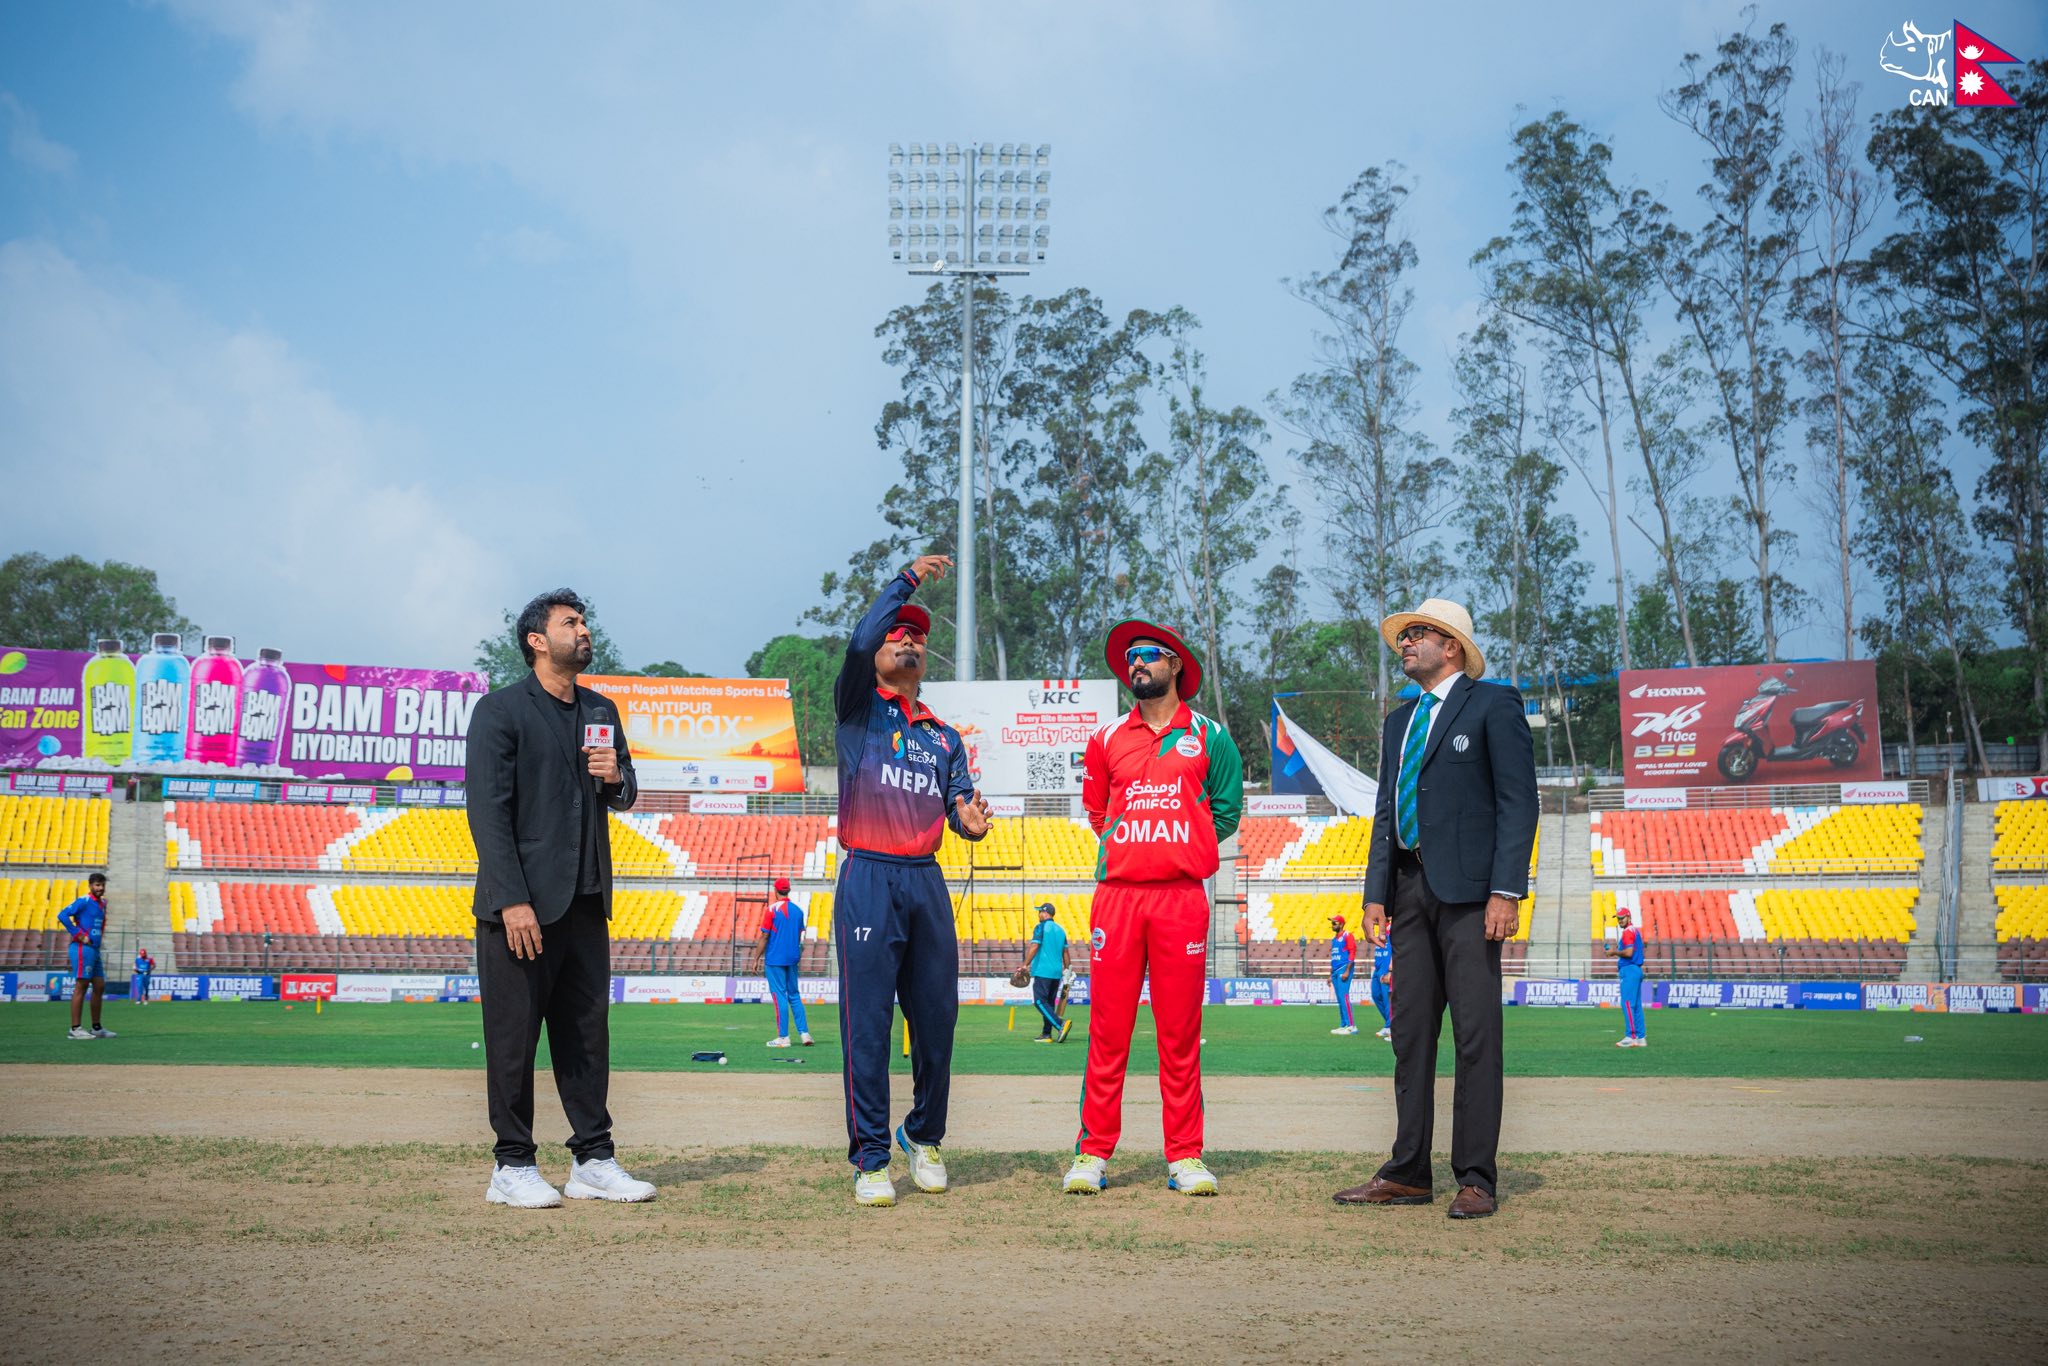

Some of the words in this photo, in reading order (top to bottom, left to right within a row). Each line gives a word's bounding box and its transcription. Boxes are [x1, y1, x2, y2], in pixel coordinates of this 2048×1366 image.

[0, 687, 36, 705] BAM
[39, 687, 75, 705] BAM
[94, 682, 130, 708] BAM
[146, 679, 182, 707] BAM
[199, 680, 236, 708] BAM
[591, 683, 629, 694] Where
[632, 684, 668, 696] Nepal
[670, 685, 723, 696] Watches
[725, 686, 765, 698] Sports
[767, 687, 785, 697] Liv
[1042, 691, 1080, 705] KFC
[1646, 686, 1706, 698] HONDA
[247, 690, 281, 715] BAM
[292, 682, 384, 733] BAM
[394, 687, 484, 737] BAM
[628, 700, 712, 714] KANTIPUR
[31, 707, 80, 728] Zone
[656, 714, 741, 740] max
[1002, 727, 1060, 746] Loyalty
[291, 732, 412, 764] HYDRATION
[416, 738, 466, 766] DRIN
[1634, 743, 1696, 758] BS6
[881, 763, 942, 798] NEPA
[1639, 796, 1682, 804] HONDA
[1857, 789, 1905, 799] HONDA
[705, 802, 744, 810] HONDA
[1113, 819, 1190, 844] OMAN
[854, 926, 872, 941] 17
[208, 977, 262, 991] XTREME
[300, 981, 333, 993] KFC
[459, 978, 480, 987] NAA
[735, 980, 769, 993] XTRE
[958, 980, 980, 992] IGER
[1235, 981, 1270, 990] NAASA
[1278, 980, 1301, 992] MAX
[1526, 983, 1578, 996] XTREME
[1587, 983, 1621, 996] XTRE
[1668, 983, 1722, 998] XTREME
[1732, 984, 1788, 999] XTREME
[1865, 984, 1892, 998] MAX
[1897, 985, 1927, 999] TIGER
[1950, 985, 1978, 999] MAX
[1981, 986, 2015, 1000] TIGER
